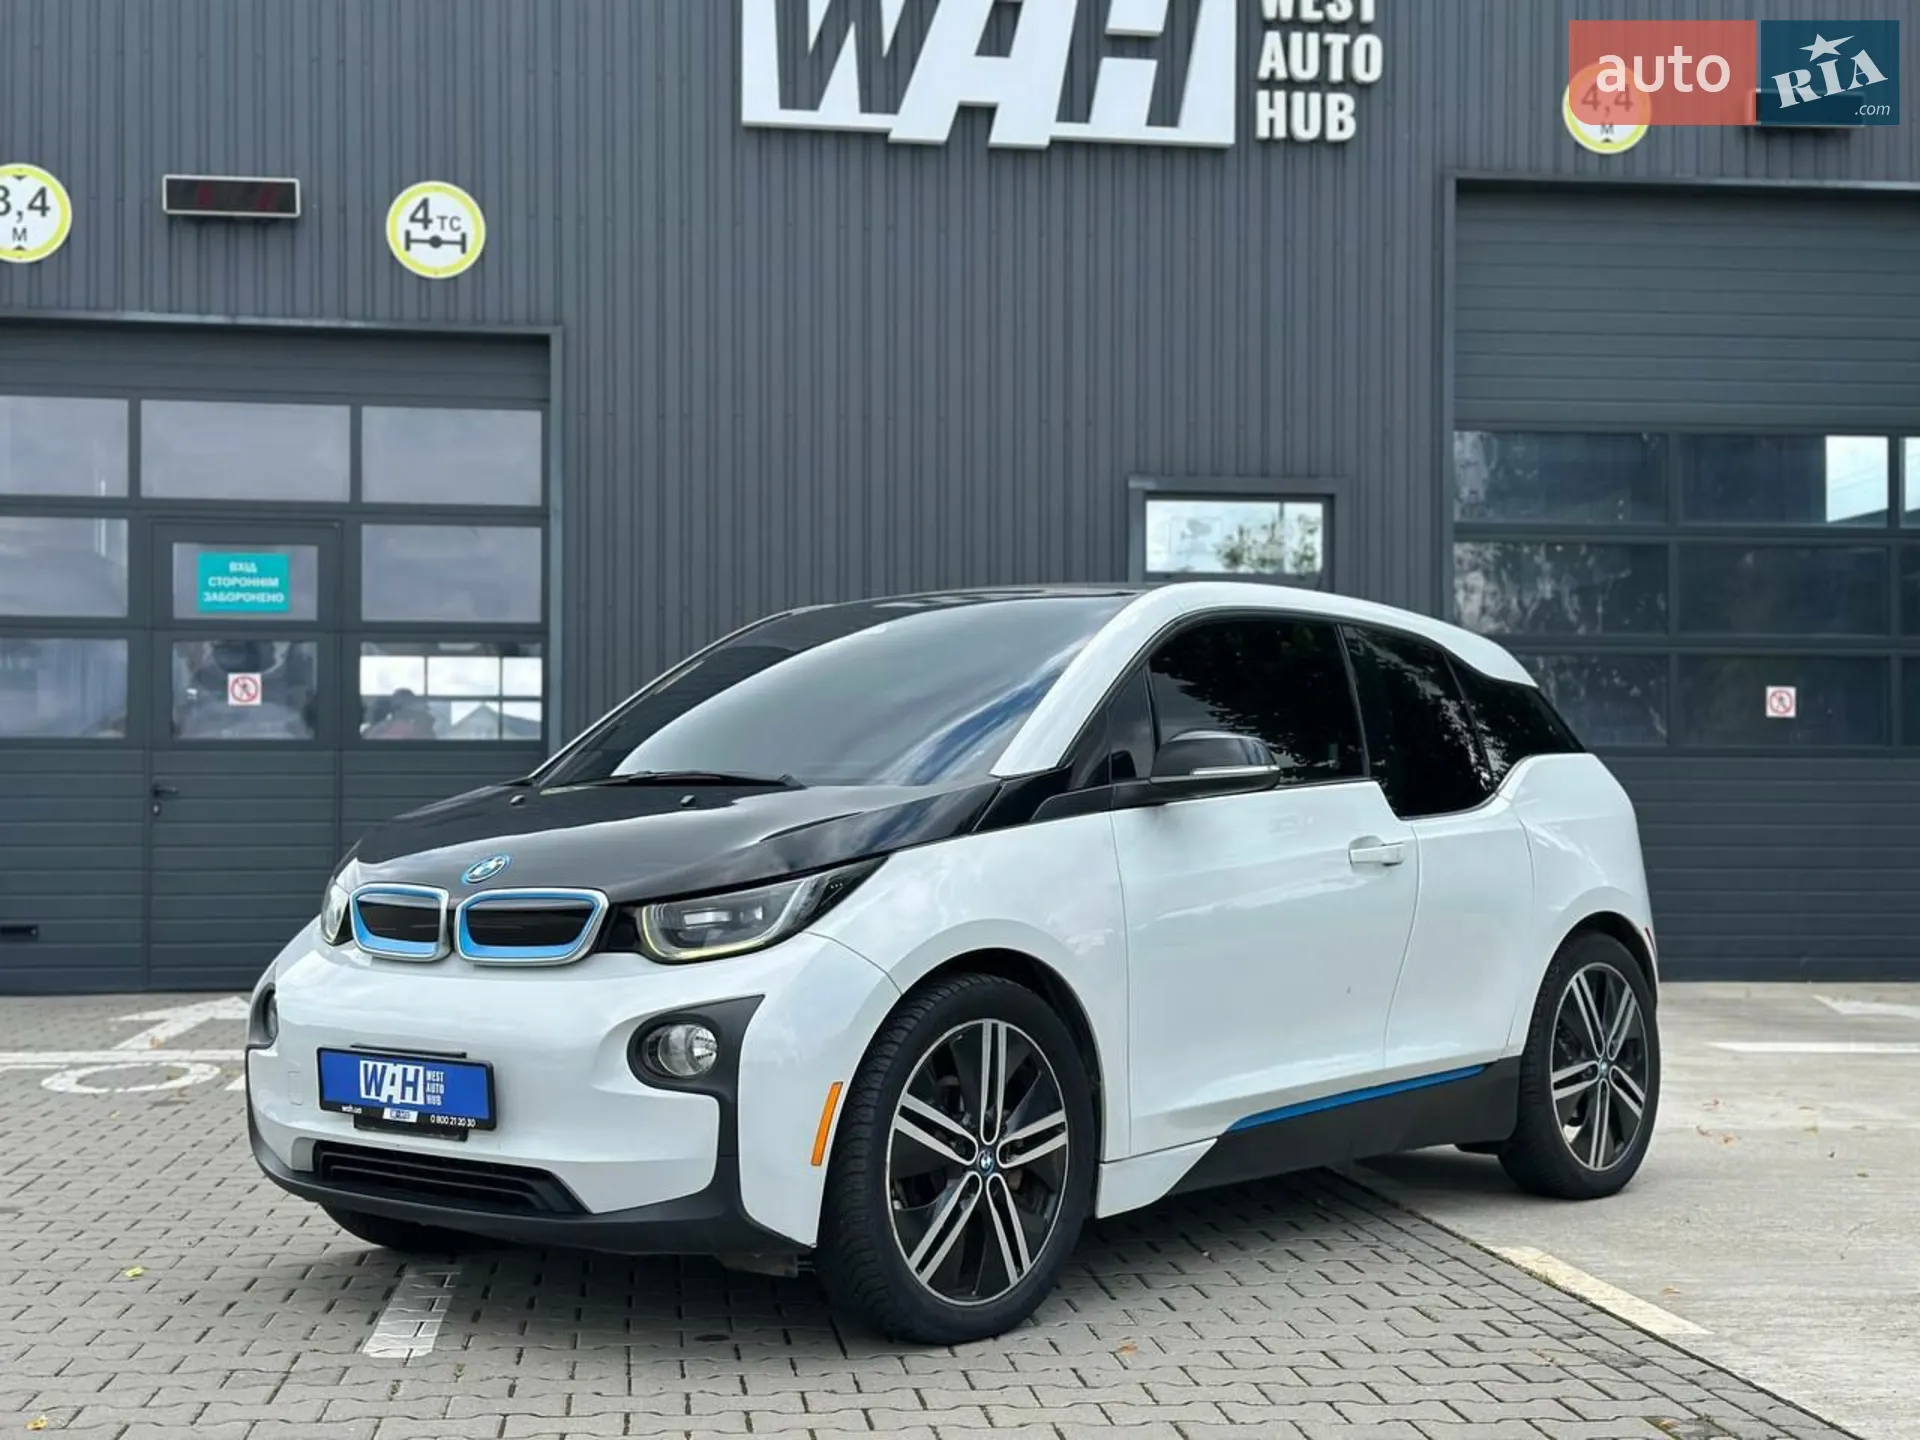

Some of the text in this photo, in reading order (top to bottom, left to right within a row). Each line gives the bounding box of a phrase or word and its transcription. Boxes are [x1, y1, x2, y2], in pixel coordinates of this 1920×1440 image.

[1257, 30, 1383, 84] AUTO
[1256, 89, 1357, 142] HUB
[203, 592, 285, 604] ЗАБОРОНЕНО
[359, 1060, 425, 1105] WAH
[426, 1070, 444, 1083] WEST
[426, 1082, 445, 1095] AUTO
[426, 1094, 442, 1106] HUB
